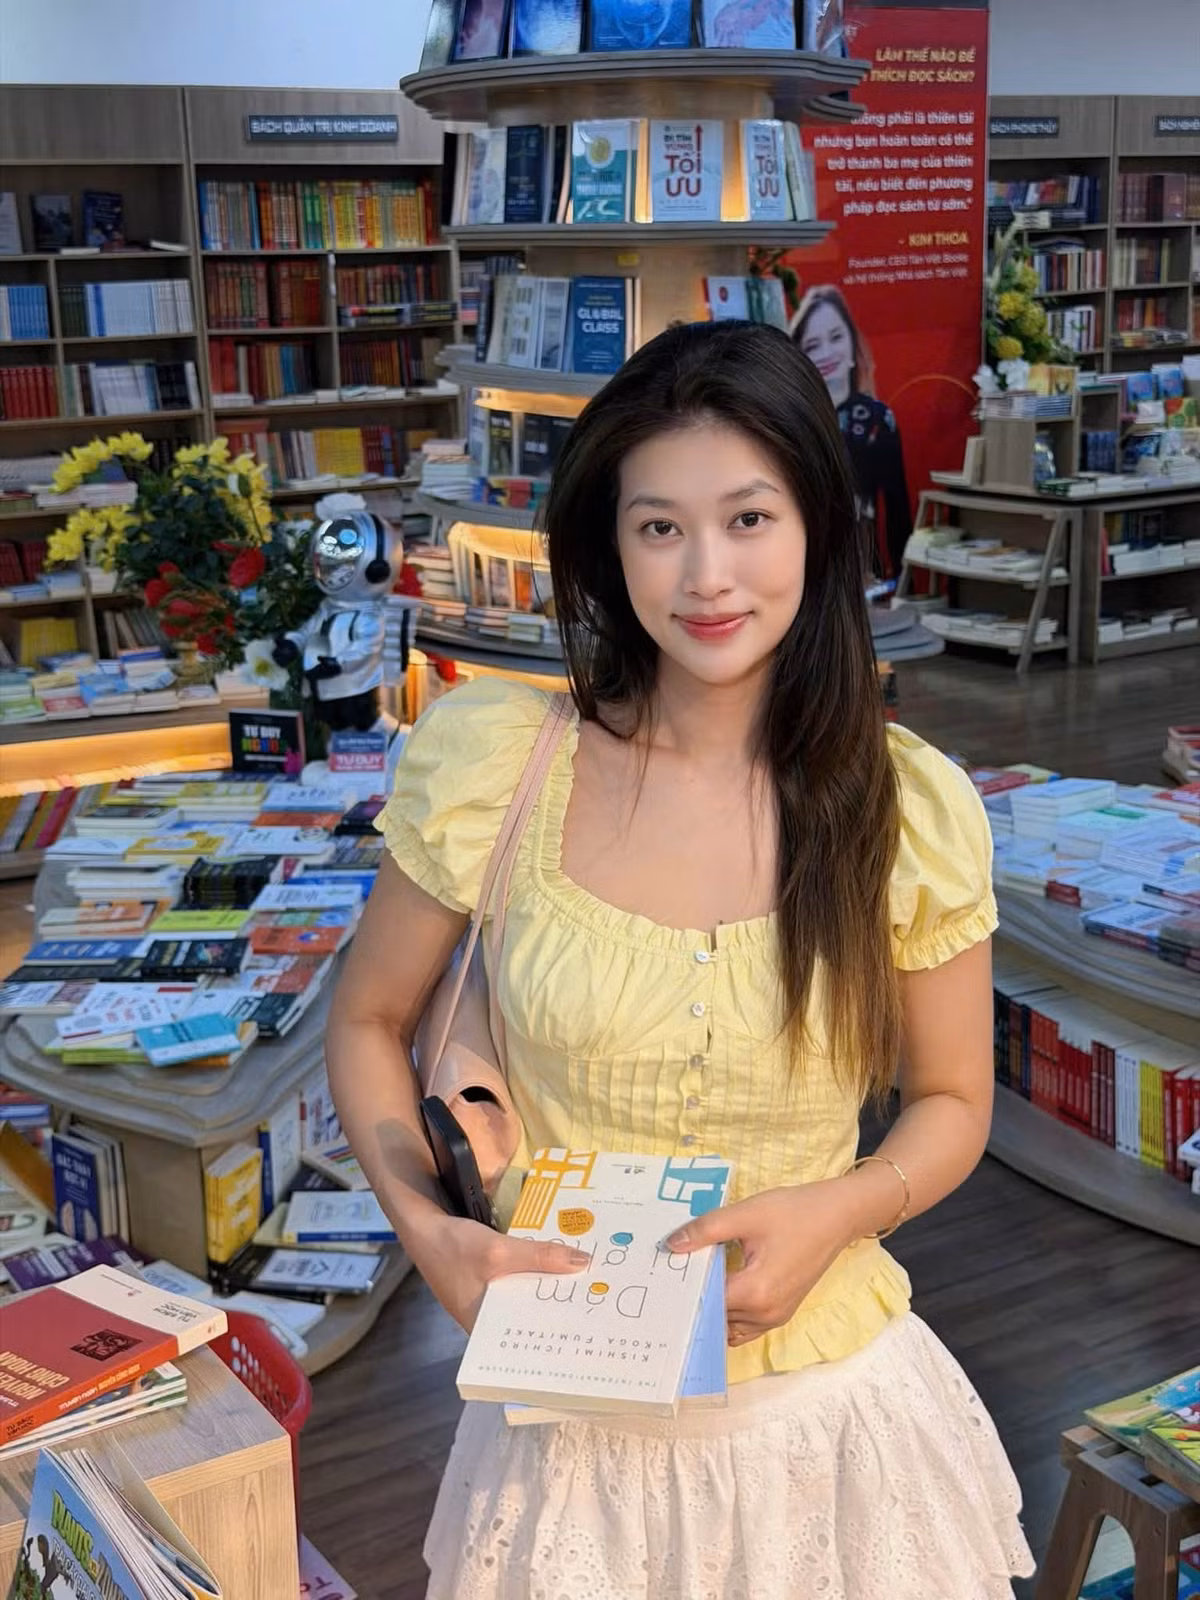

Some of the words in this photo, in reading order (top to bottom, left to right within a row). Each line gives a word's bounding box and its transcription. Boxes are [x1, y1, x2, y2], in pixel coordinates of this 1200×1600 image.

[664, 151, 702, 174] TỐI
[666, 177, 702, 197] ƯU
[908, 232, 933, 247] KIM
[934, 231, 970, 246] THOA
[582, 321, 620, 334] CLASS
[535, 1277, 649, 1319] Dám
[503, 1327, 594, 1344] FUMITAKE
[608, 1337, 652, 1350] KOGA
[499, 1340, 562, 1356] ICHIRO
[575, 1347, 650, 1363] KISHIMI
[25, 1367, 70, 1389] CÔNG
[51, 1489, 94, 1575] PLANTS
